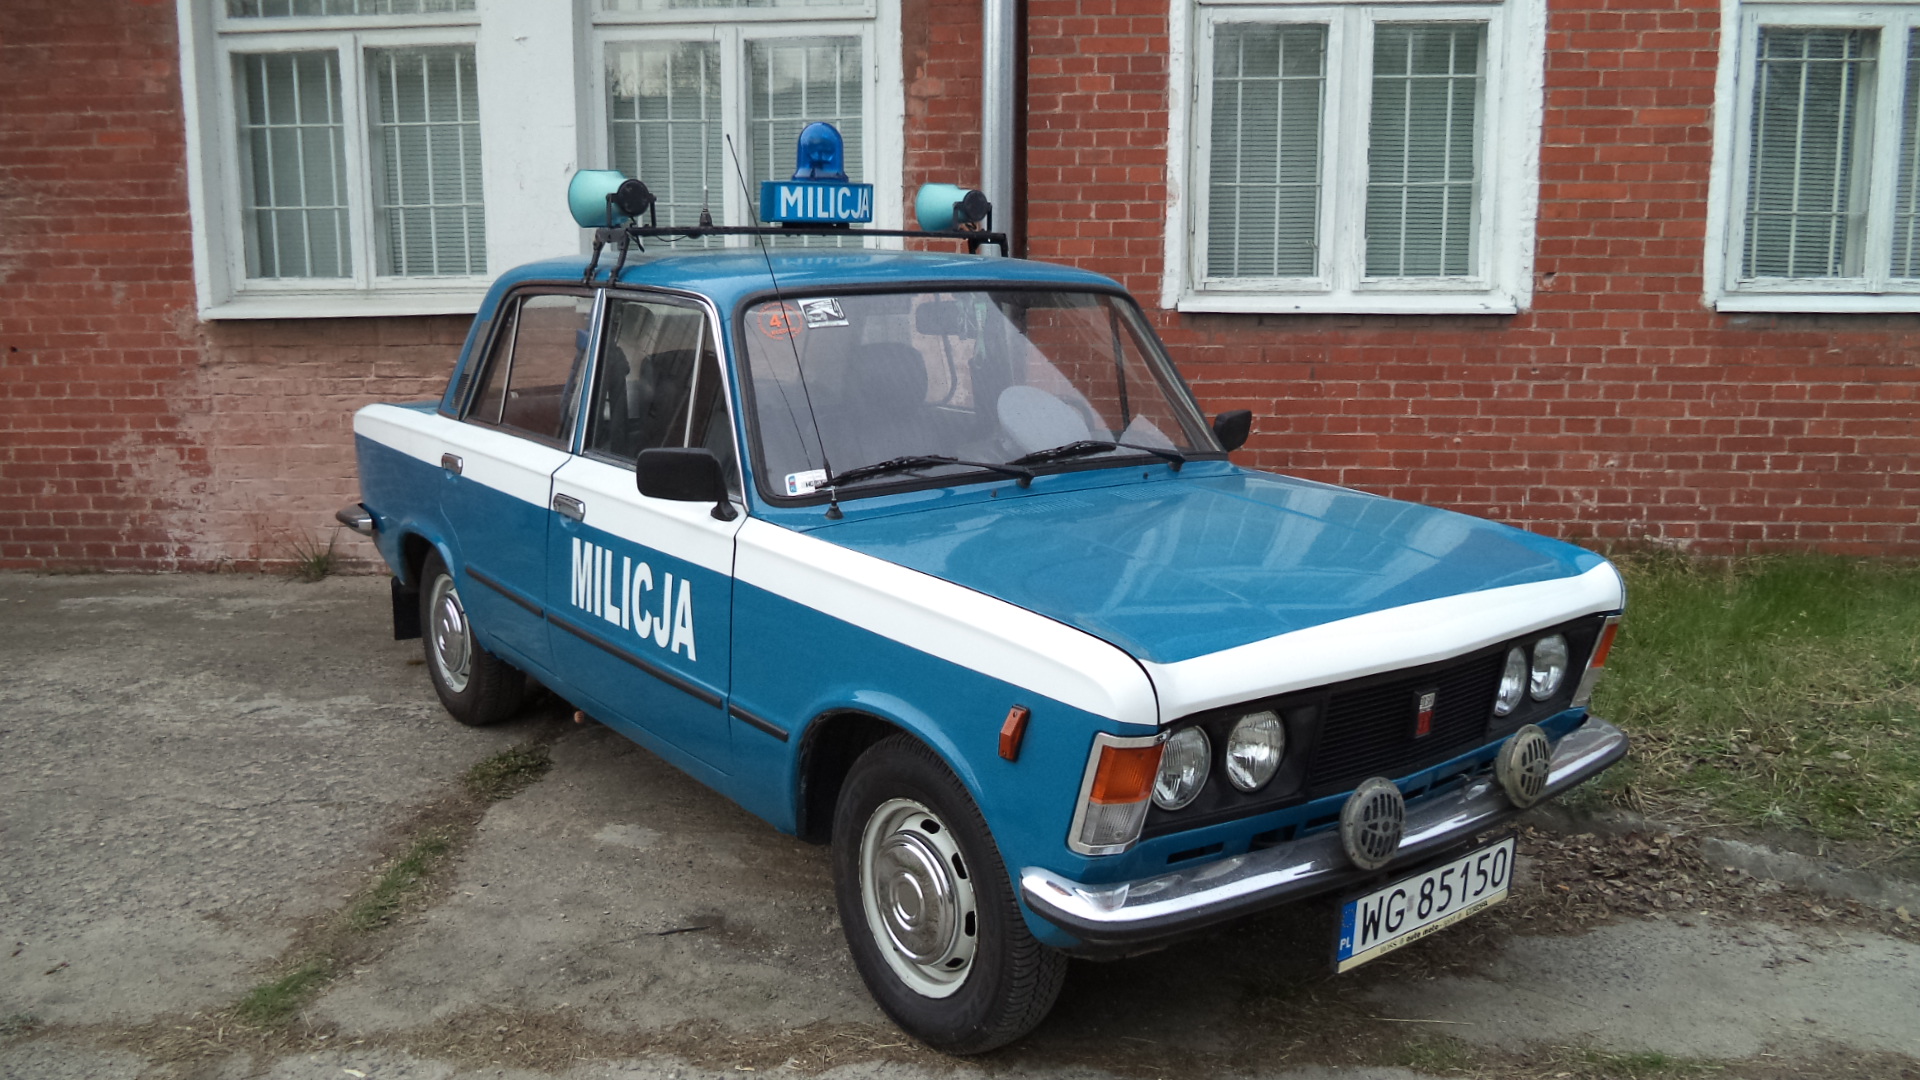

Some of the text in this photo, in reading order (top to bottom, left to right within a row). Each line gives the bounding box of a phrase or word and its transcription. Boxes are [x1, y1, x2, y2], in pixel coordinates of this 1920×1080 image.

[780, 185, 870, 219] MILICJA
[571, 536, 697, 662] MILICJA
[1361, 847, 1507, 946] WG 85150
[1339, 936, 1352, 951] PL
